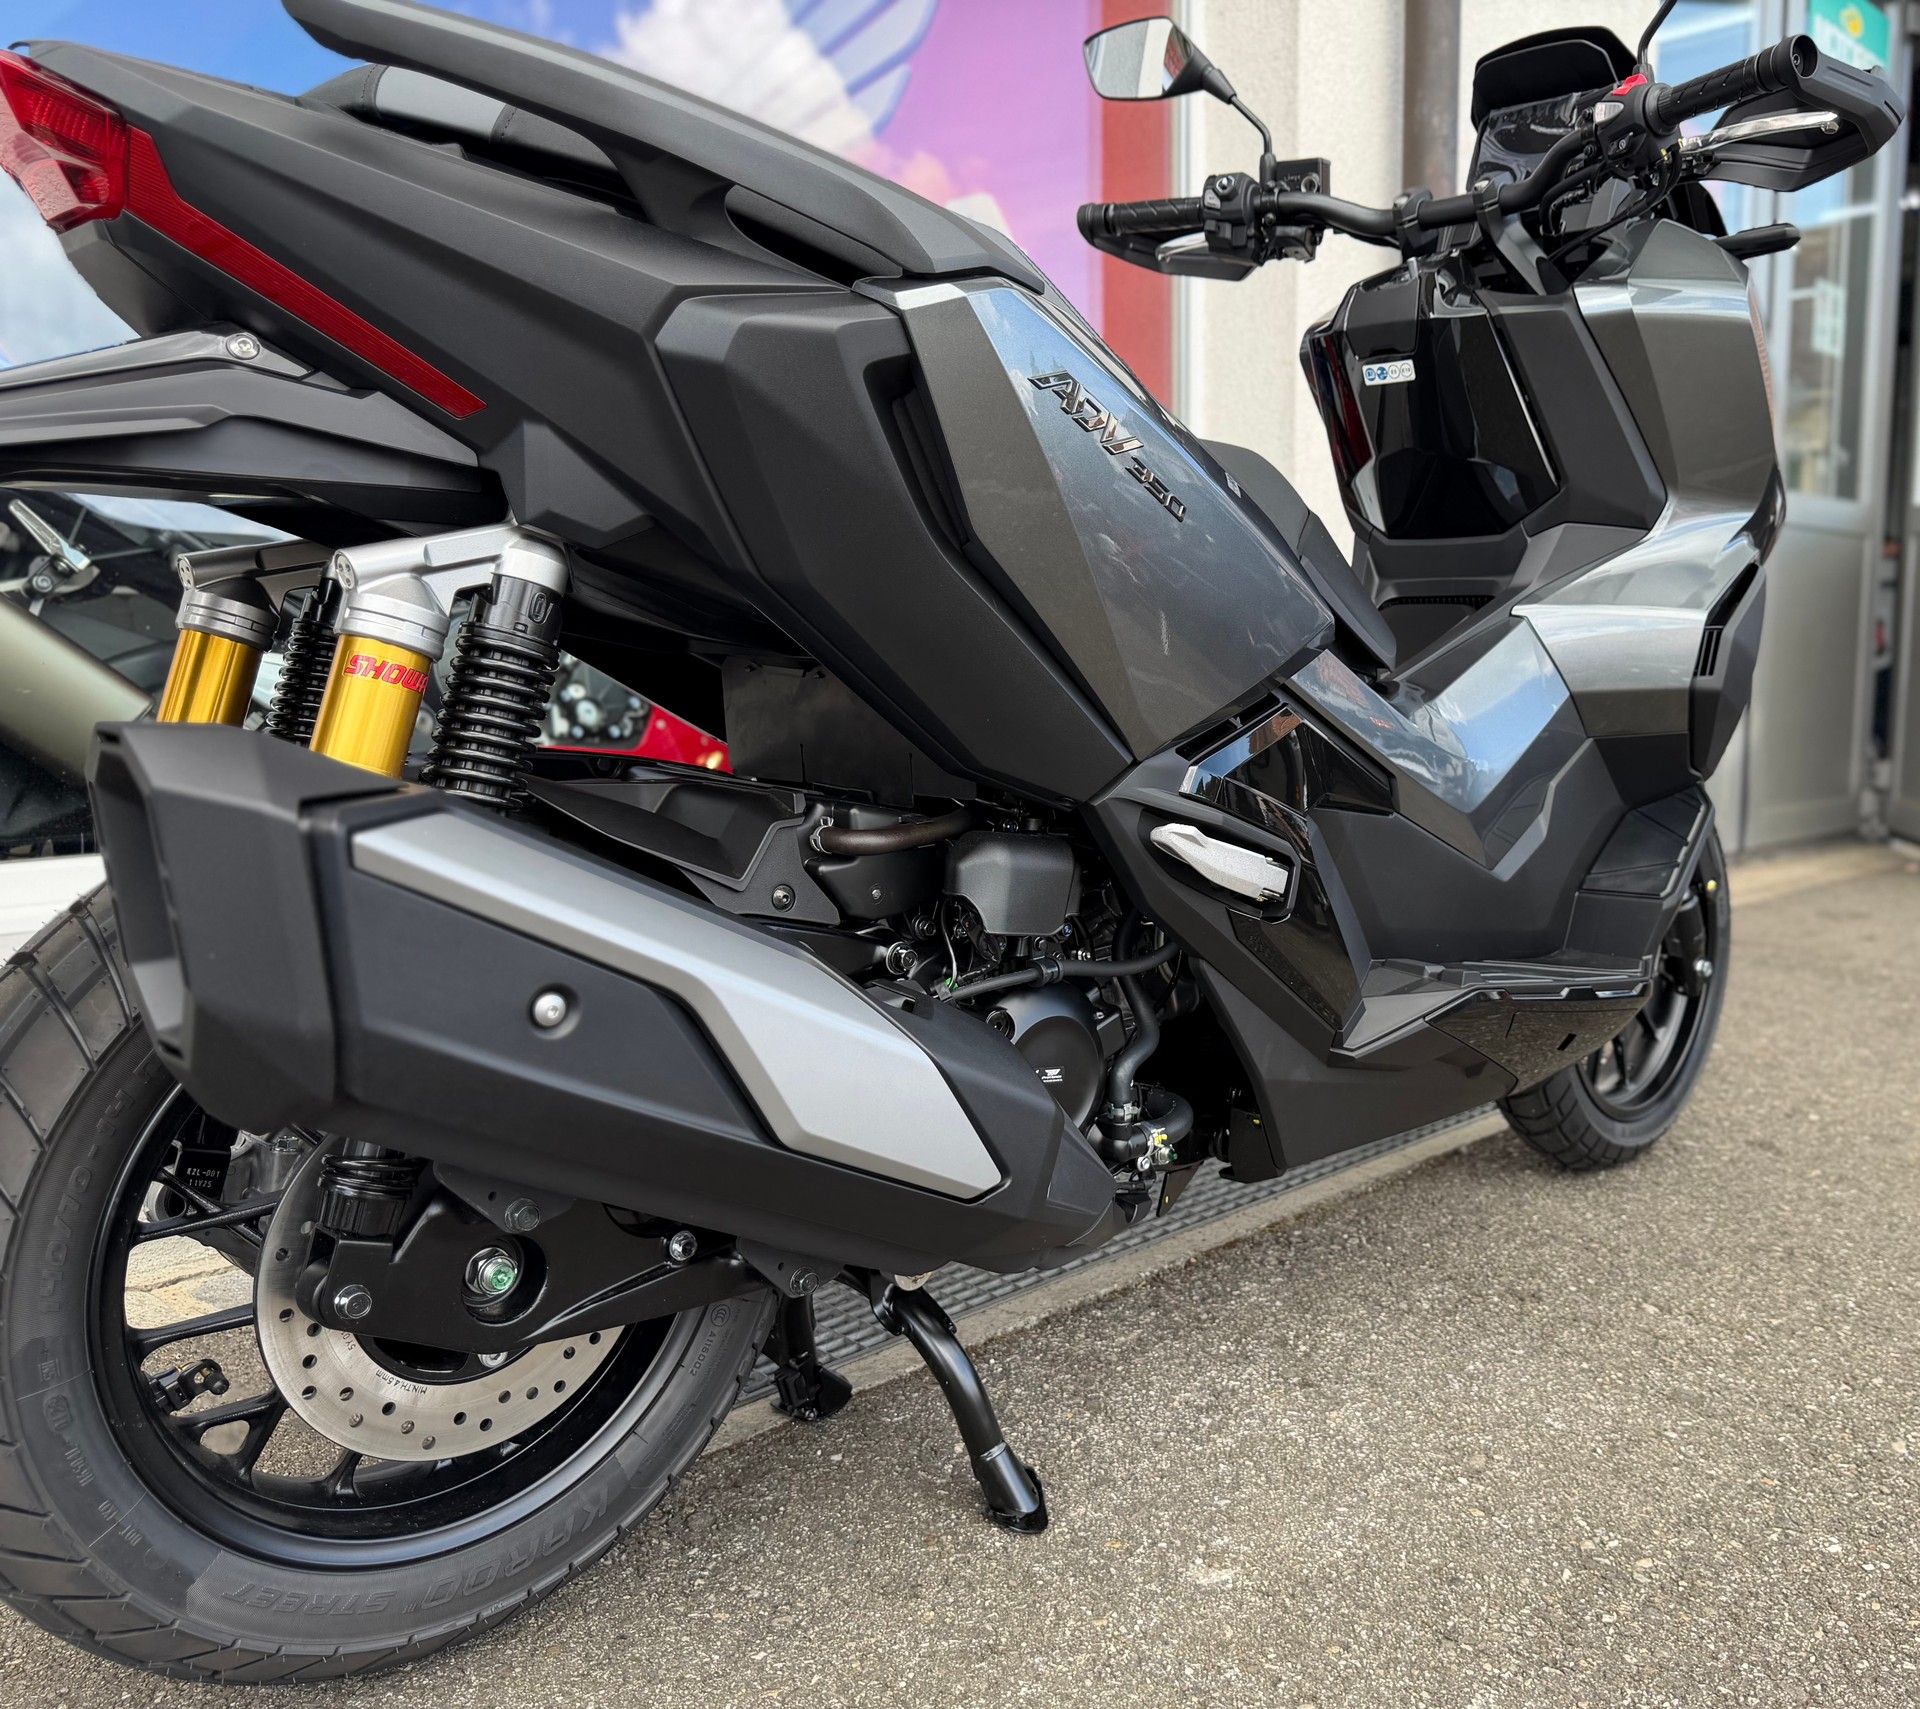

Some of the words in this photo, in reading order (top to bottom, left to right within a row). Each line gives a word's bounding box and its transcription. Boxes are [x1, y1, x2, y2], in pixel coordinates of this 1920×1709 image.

[1027, 370, 1145, 456] ADV
[1125, 455, 1187, 523] 350
[221, 1582, 399, 1617] STREET
[421, 1487, 610, 1612] KAROO
